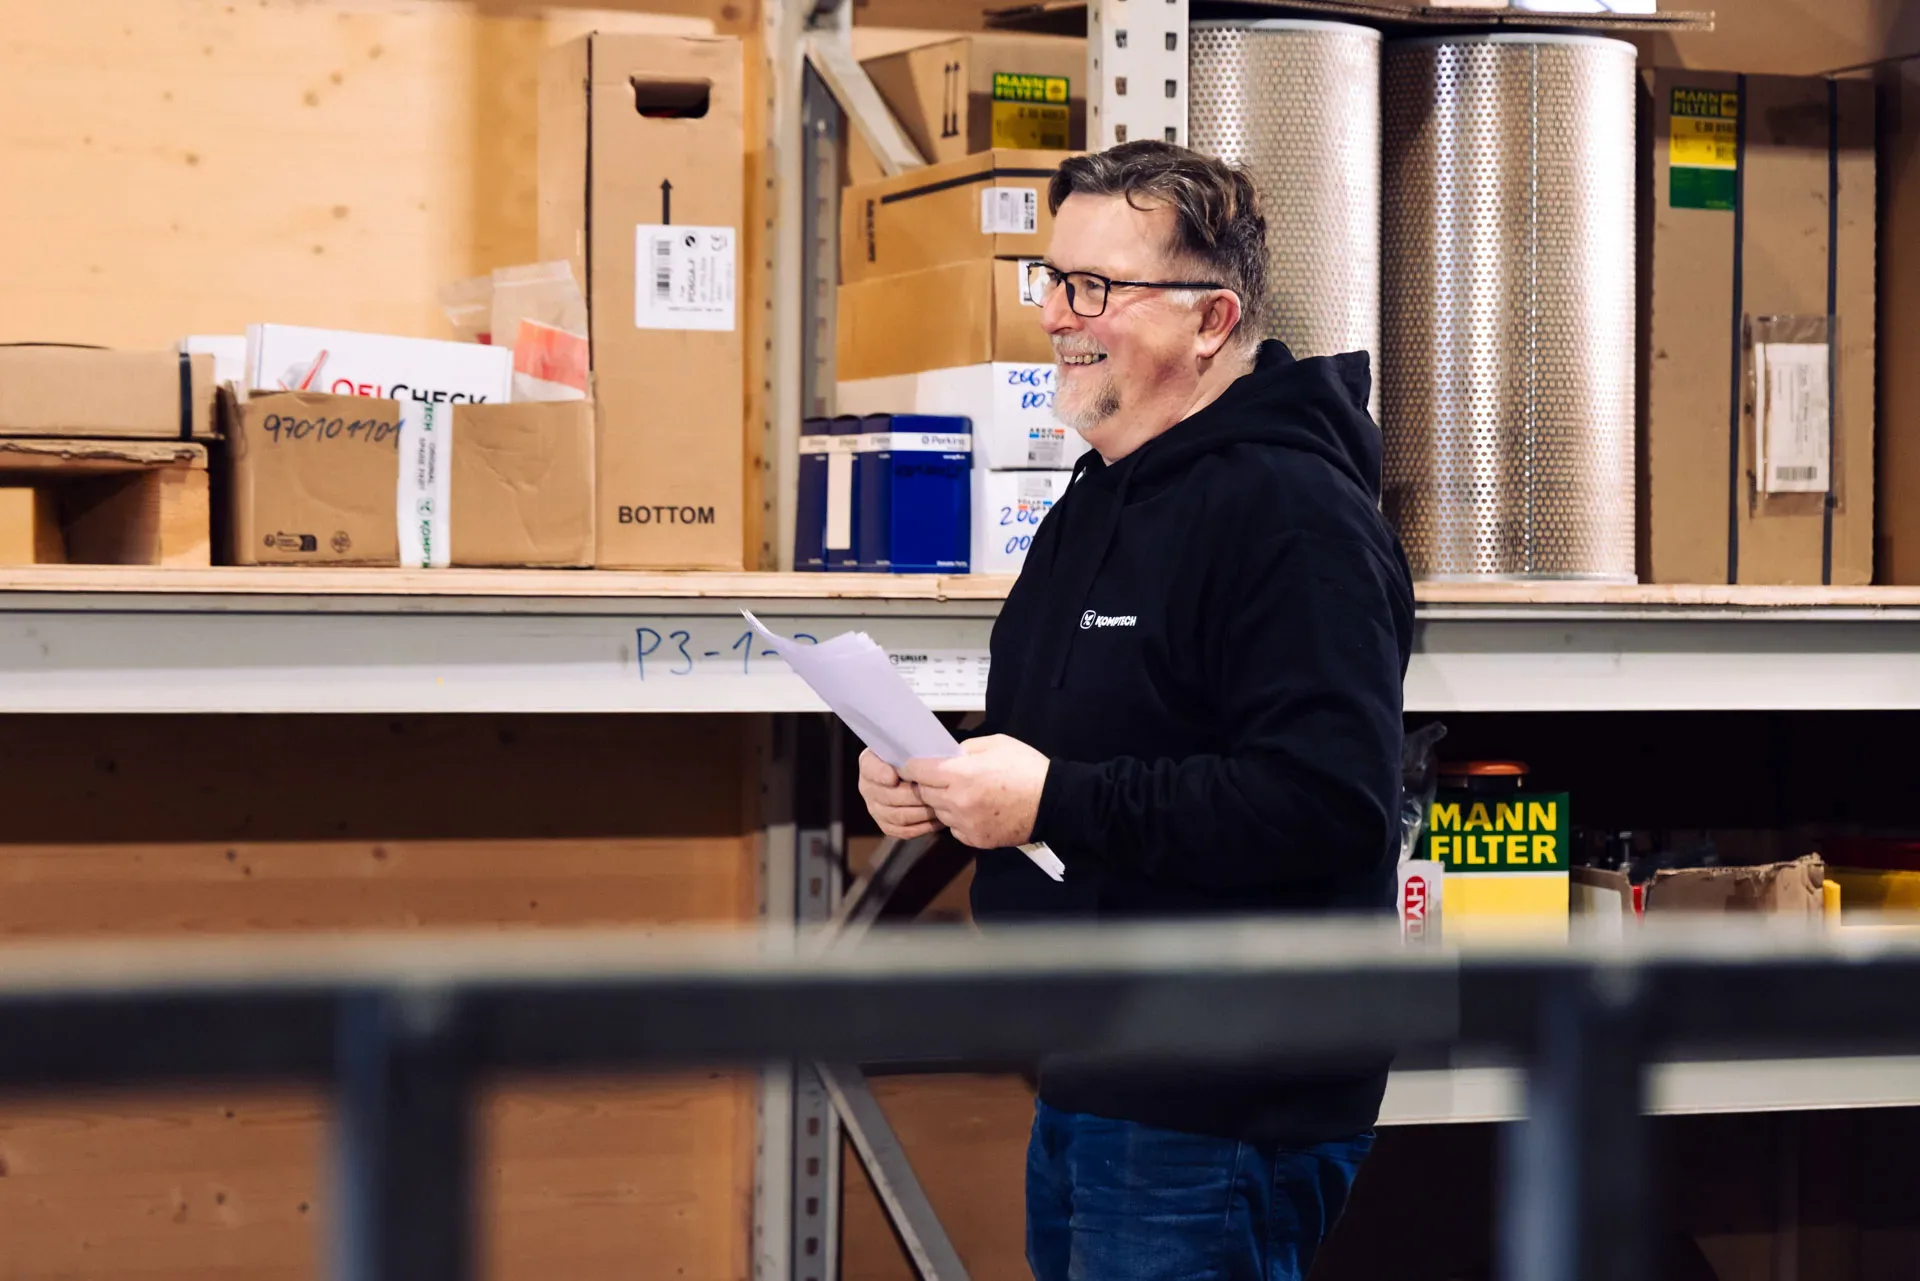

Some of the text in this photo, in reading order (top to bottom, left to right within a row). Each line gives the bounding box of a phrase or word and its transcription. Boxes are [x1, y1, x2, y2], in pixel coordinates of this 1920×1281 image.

[996, 75, 1044, 89] MANN
[1674, 89, 1719, 104] MANN
[1673, 101, 1718, 116] FILTER
[618, 505, 715, 524] BOTTOM
[1095, 615, 1137, 628] KOMPTECH
[1430, 802, 1557, 831] MANN
[1430, 834, 1558, 865] FILTER
